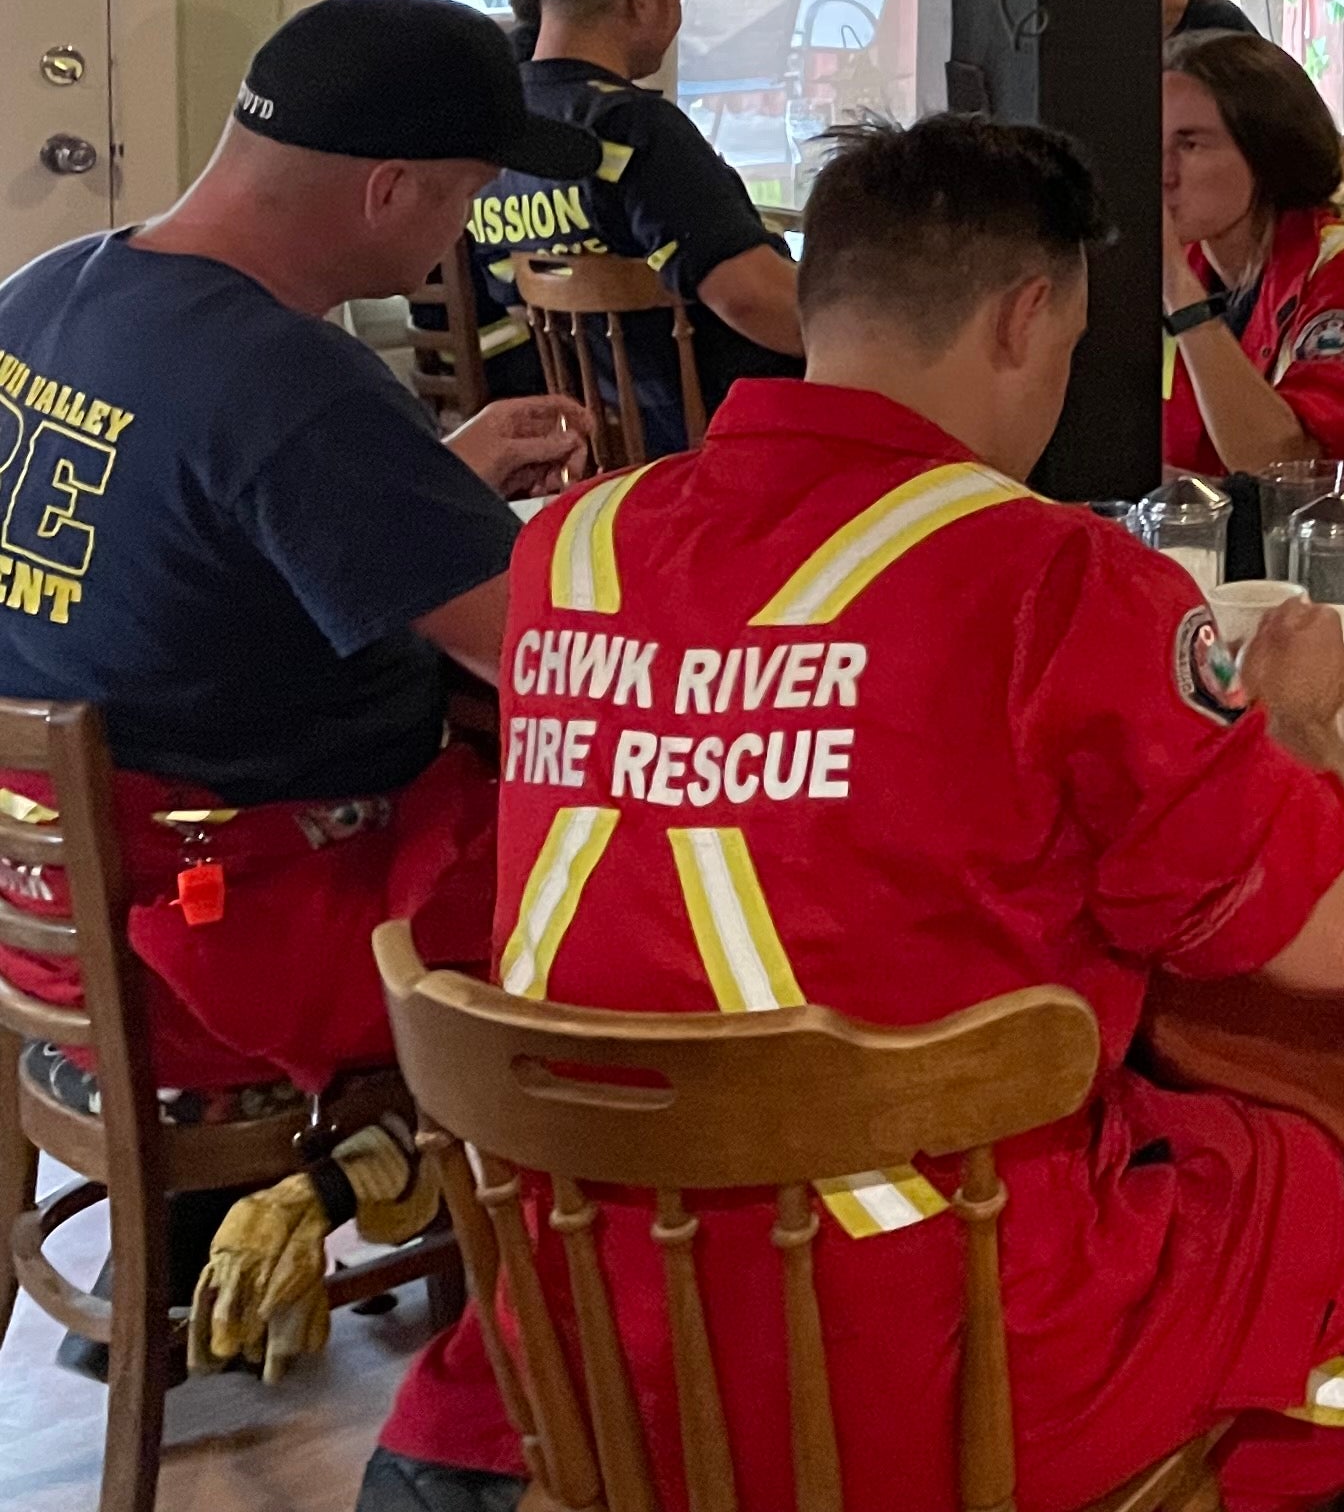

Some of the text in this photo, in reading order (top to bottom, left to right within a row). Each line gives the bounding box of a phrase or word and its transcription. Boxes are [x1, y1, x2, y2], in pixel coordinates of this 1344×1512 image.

[25, 374, 136, 443] VALLEY
[513, 628, 867, 716] CHWK RIVER
[504, 716, 855, 807] FIRE RESCUE
